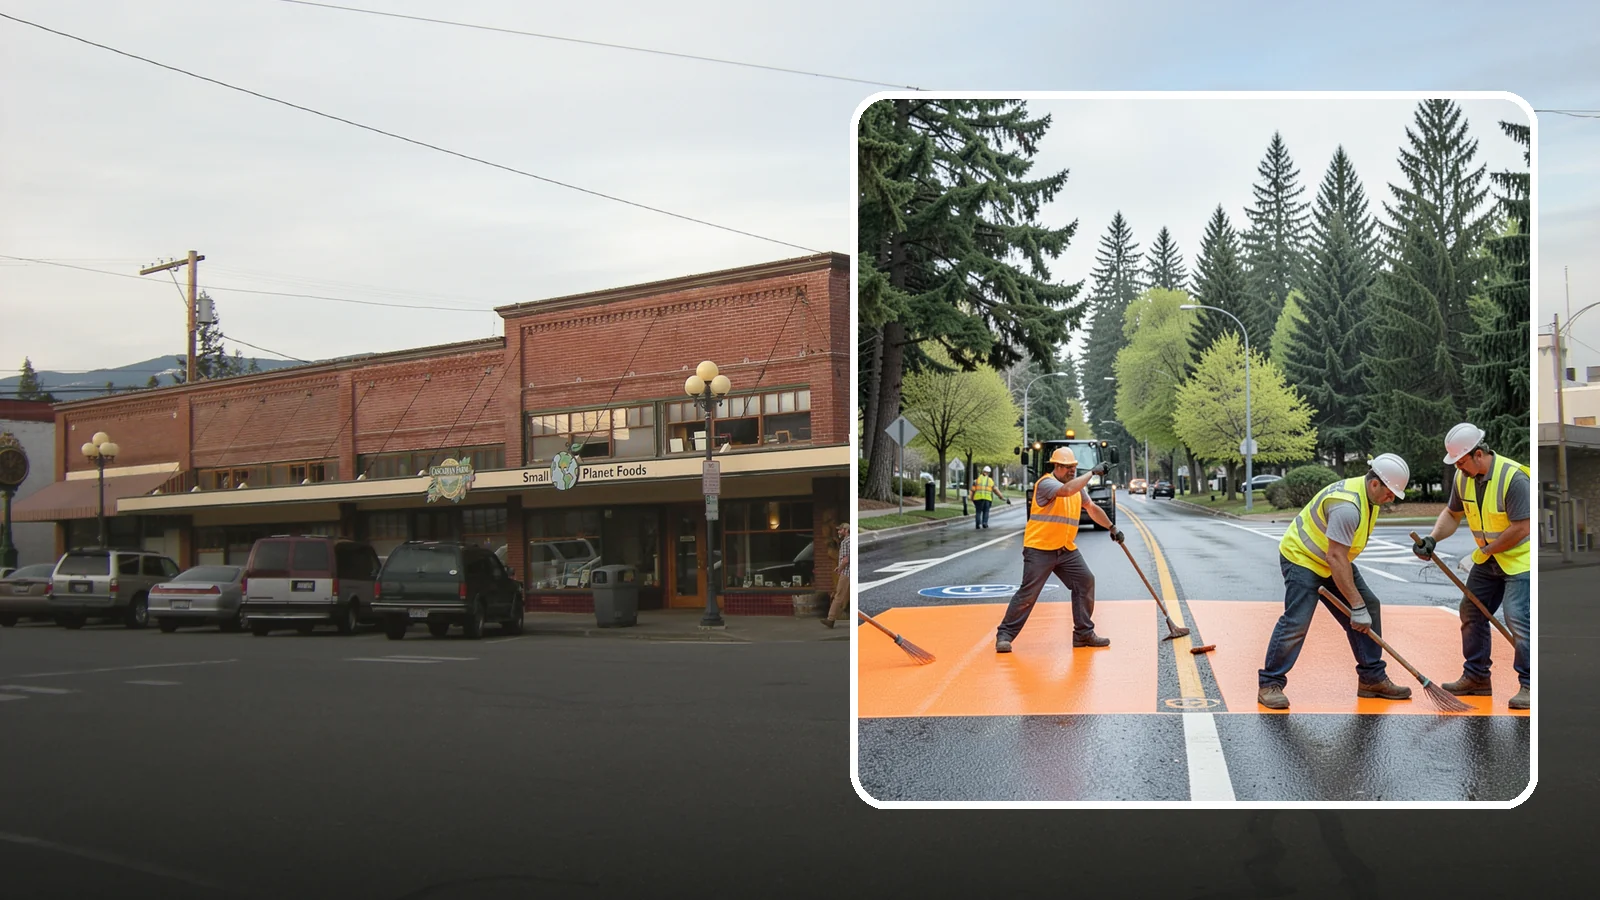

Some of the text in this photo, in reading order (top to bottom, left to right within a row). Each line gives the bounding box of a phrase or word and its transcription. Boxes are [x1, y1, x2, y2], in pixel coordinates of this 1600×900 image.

[523, 464, 647, 483] Small Planet Foods
